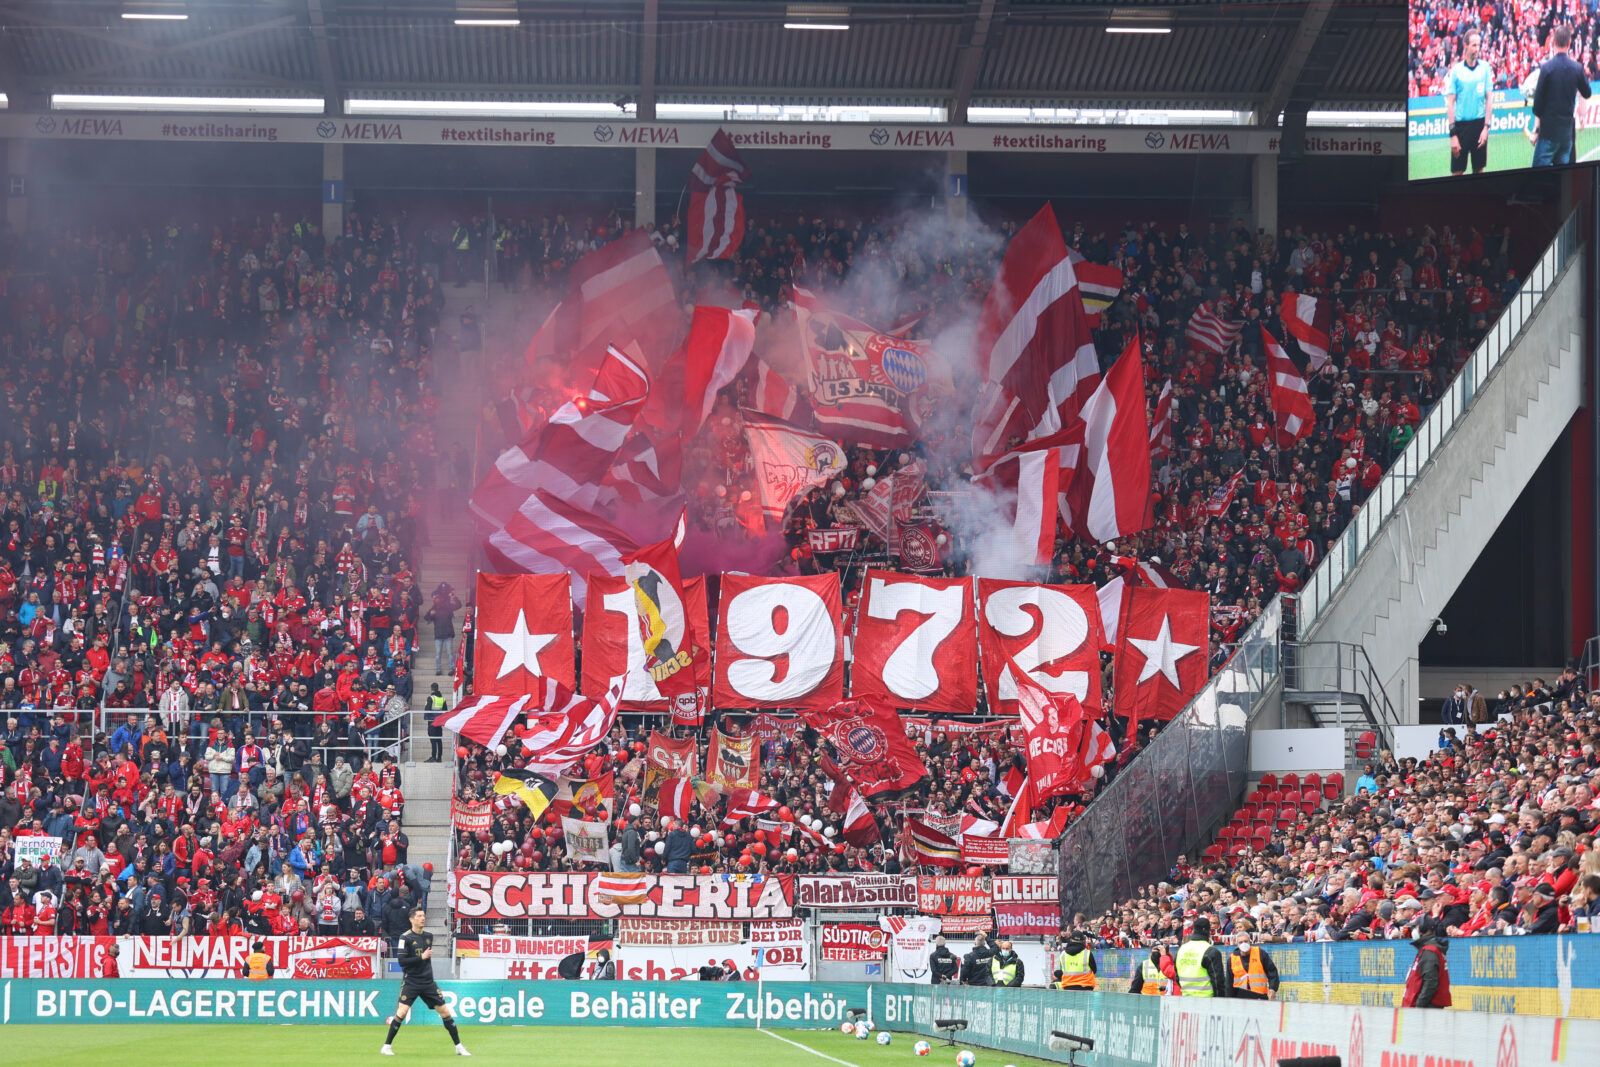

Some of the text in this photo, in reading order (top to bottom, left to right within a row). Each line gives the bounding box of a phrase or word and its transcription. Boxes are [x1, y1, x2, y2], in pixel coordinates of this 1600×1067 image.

[61, 119, 124, 137] MEWA
[161, 122, 278, 141] #textilsharing
[341, 122, 403, 140] MEWA
[441, 127, 556, 145] #textilsharing
[618, 127, 679, 144] MEWA
[894, 129, 955, 147] MEWA
[992, 134, 1108, 152] #textilsharing
[1169, 132, 1231, 150] MEWA
[809, 529, 858, 549] RFM
[993, 878, 1059, 900] COLEGIO
[921, 893, 992, 913] RED PRIDE
[752, 919, 803, 929] WIR SIND
[619, 930, 740, 945] IMMER BEI UNS
[751, 929, 803, 942] BEI DIR
[483, 938, 511, 953] RED
[36, 988, 847, 1023] BITO-LAGERTECHNIK Regale Behälter Zubehör
